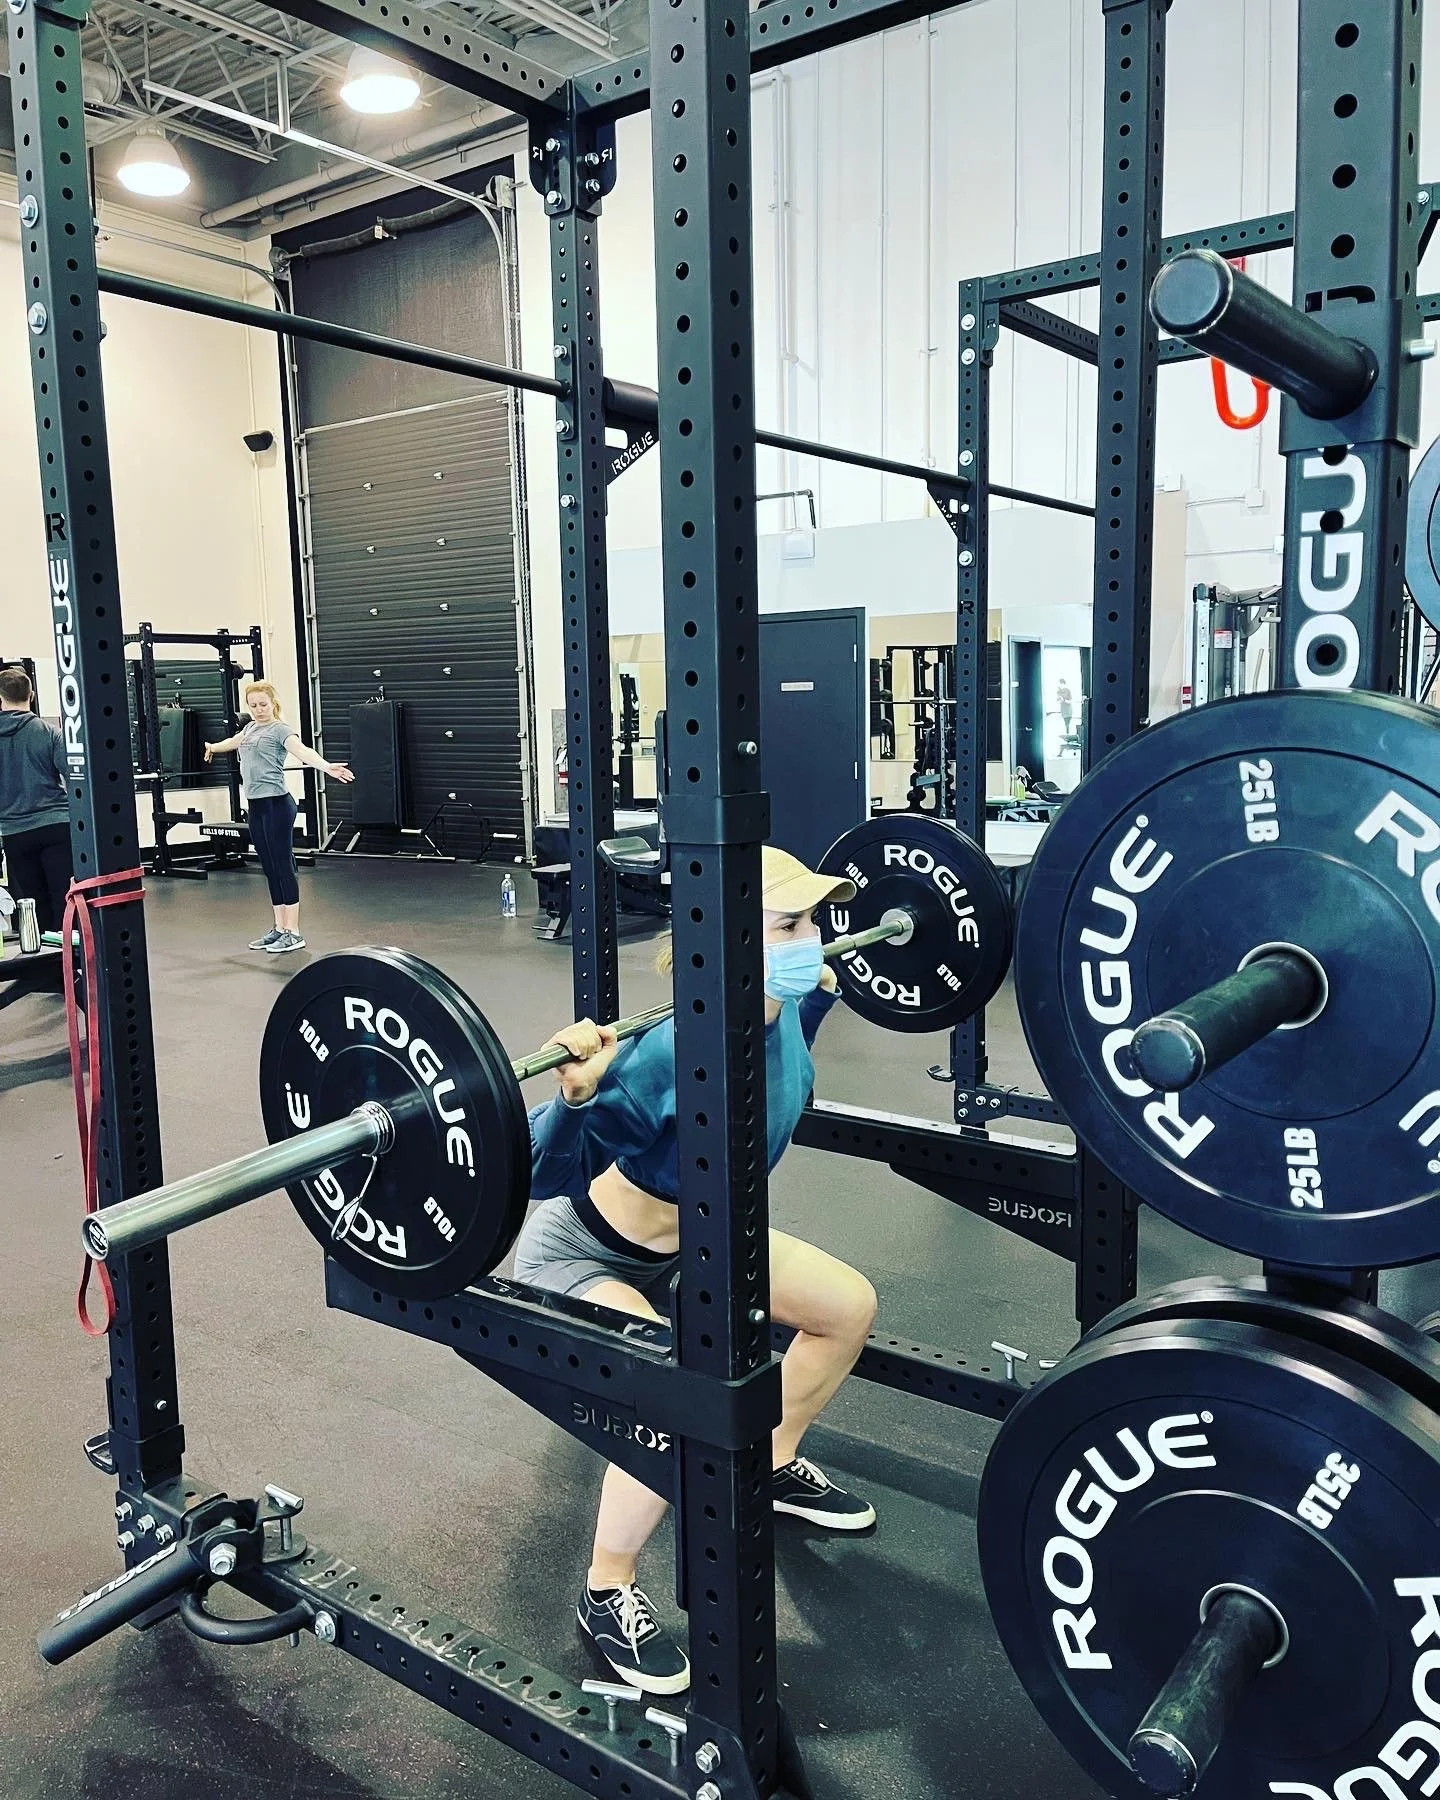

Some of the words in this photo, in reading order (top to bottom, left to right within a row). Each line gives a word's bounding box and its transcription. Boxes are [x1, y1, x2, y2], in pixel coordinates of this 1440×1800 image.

[611, 431, 654, 475] ROGUE
[46, 513, 67, 543] R
[1294, 443, 1367, 690] OGU
[960, 600, 975, 616] R
[50, 556, 85, 753] ROGUE
[1238, 759, 1280, 843] 25LB
[845, 862, 869, 889] 10LB
[884, 844, 978, 945] ROGUE
[936, 963, 963, 991] 10LB
[1079, 822, 1215, 1159] ROGUE
[299, 1019, 330, 1062] 10LB
[344, 997, 474, 1170] ROGUE
[286, 1087, 407, 1258] ROGE
[1283, 1127, 1324, 1209] 25LB
[423, 1196, 457, 1243] 10LB
[1297, 1452, 1361, 1529] 35LB
[1043, 1412, 1217, 1669] ROGUE
